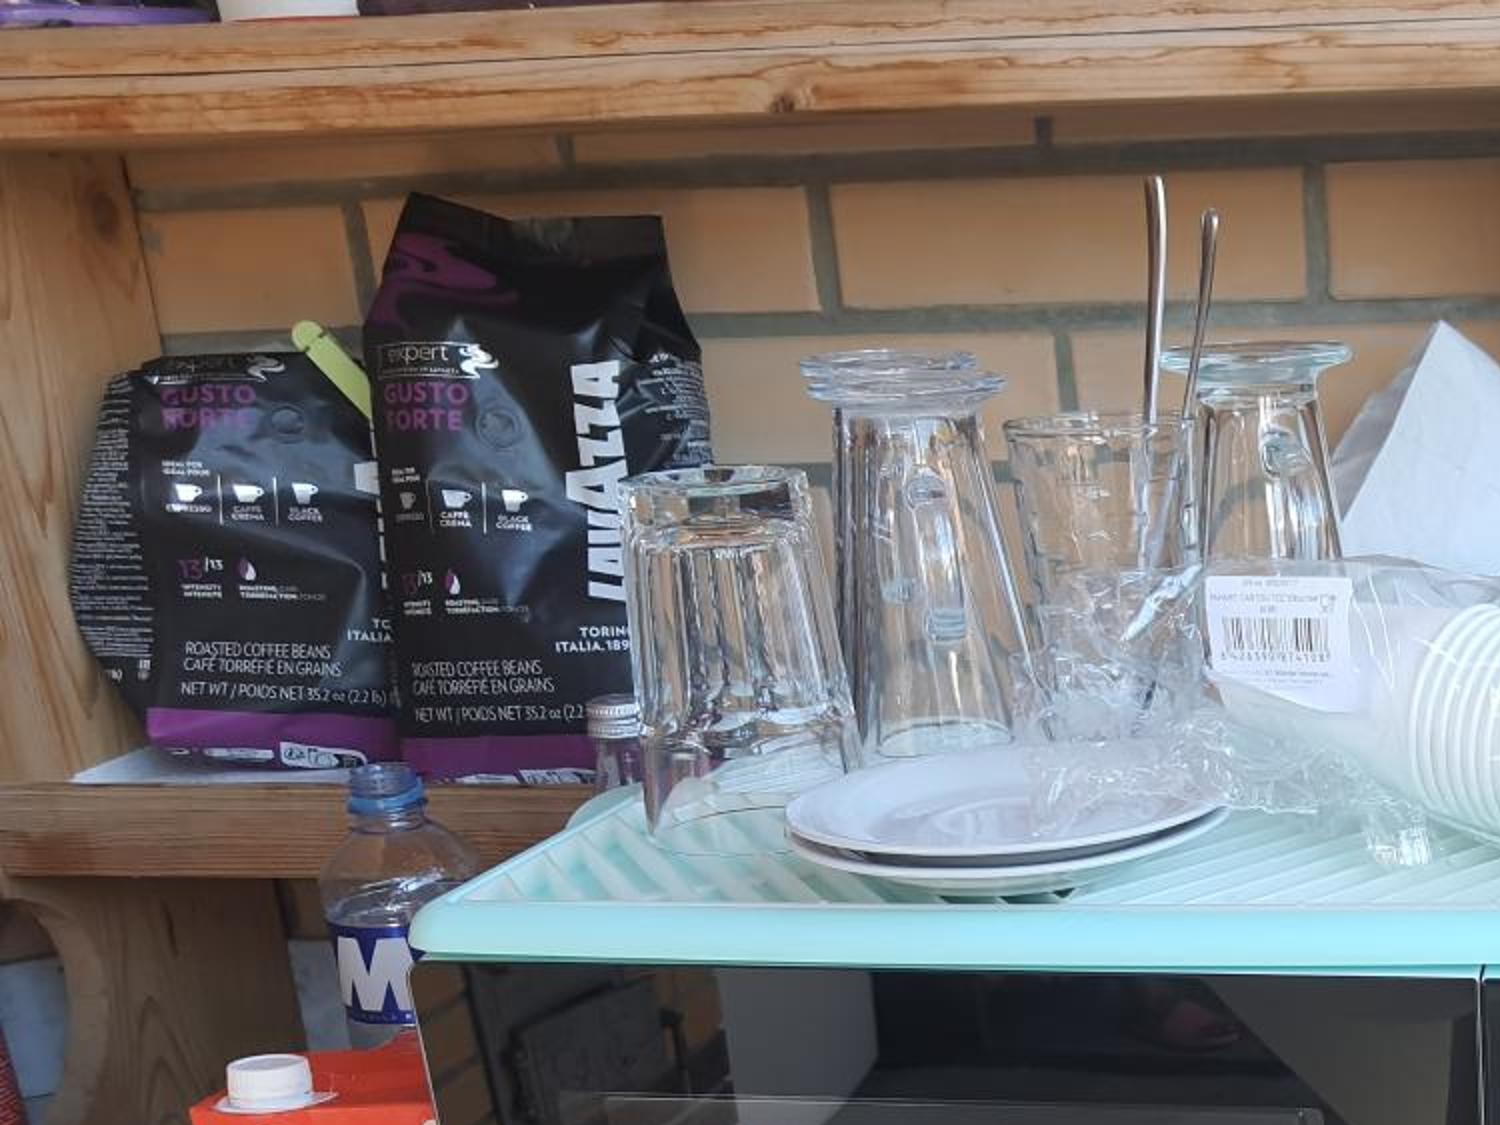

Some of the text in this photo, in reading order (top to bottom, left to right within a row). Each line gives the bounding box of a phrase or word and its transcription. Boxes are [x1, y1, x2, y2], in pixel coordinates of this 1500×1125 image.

[160, 384, 257, 404] GUSTO
[384, 382, 469, 404] GUSTO
[566, 360, 629, 602] LAVAZZA
[185, 640, 331, 659] ROASTED COFFEE BEANS
[555, 639, 632, 653] ITALIA.189
[295, 660, 342, 677] GRAINS
[456, 660, 500, 676] COFFEE
[502, 659, 543, 675] BEANS
[181, 682, 208, 696] NET
[239, 684, 277, 699] POIDS
[279, 686, 304, 702] NET
[510, 677, 556, 693] GRAINS
[462, 705, 497, 721] POIDS
[499, 705, 524, 721] NET
